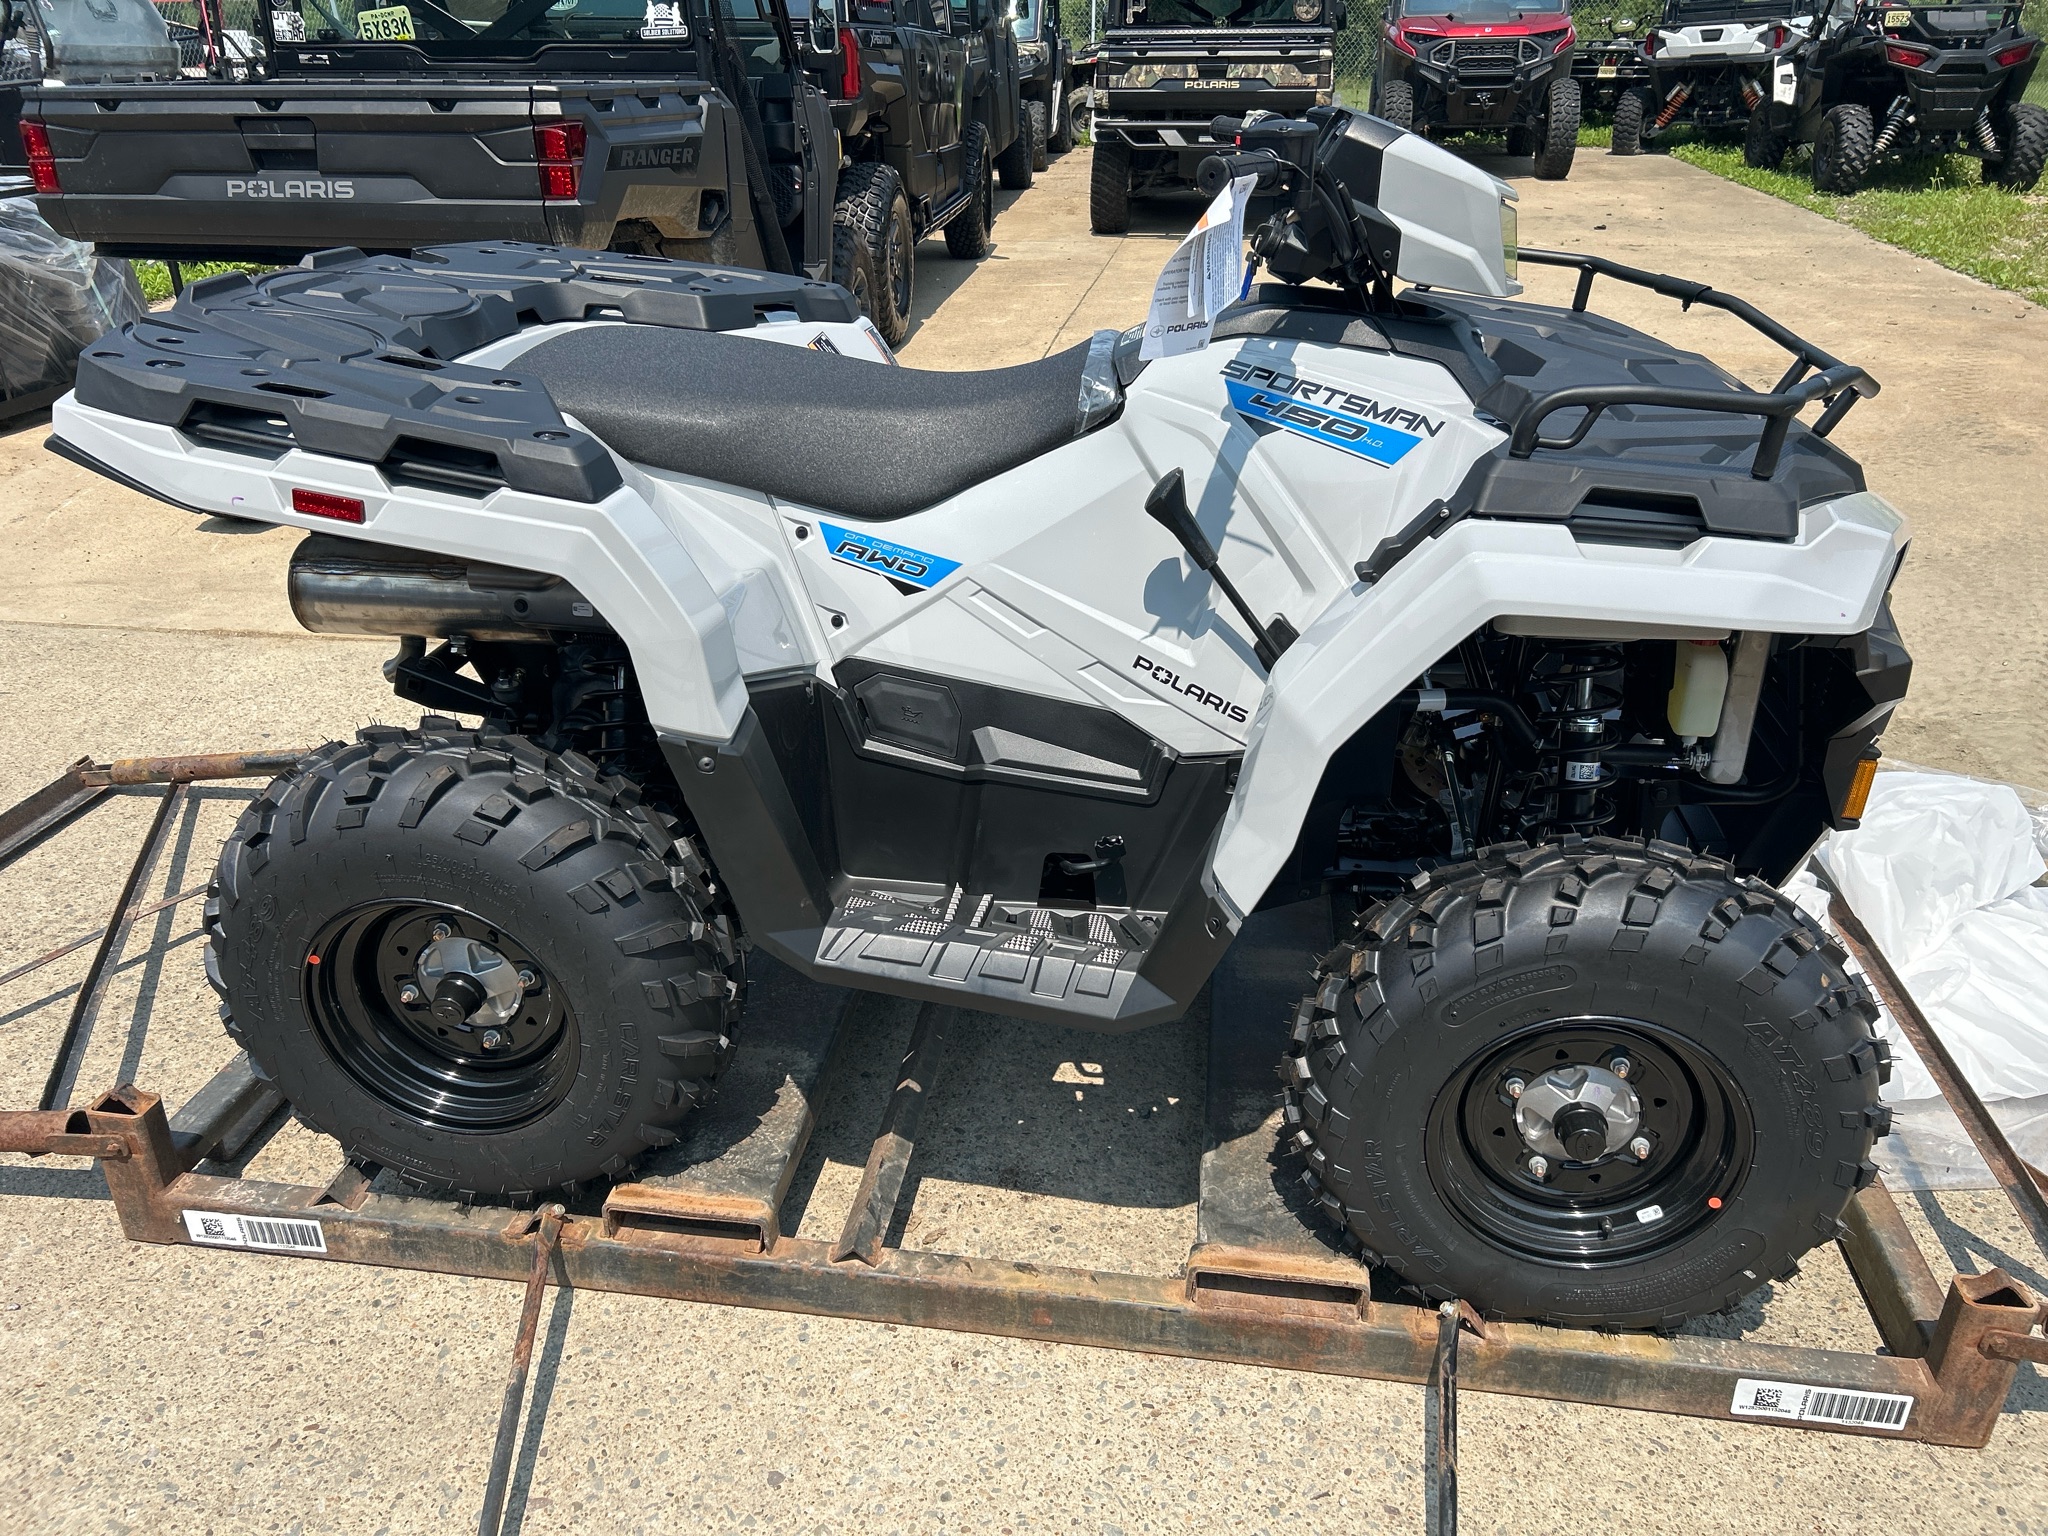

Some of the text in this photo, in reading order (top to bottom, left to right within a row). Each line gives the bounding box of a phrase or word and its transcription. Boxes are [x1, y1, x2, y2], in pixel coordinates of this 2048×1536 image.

[362, 16, 411, 40] 5X83K
[661, 28, 685, 36] SOLUTIONS
[1184, 81, 1240, 89] POLARIS
[620, 147, 695, 167] RANGER
[227, 180, 355, 199] POLARIS
[1166, 320, 1208, 334] POLARIS
[1218, 359, 1446, 438] SPORTSMAN
[1249, 393, 1384, 448] 450 H.O.
[835, 540, 928, 578] AWD
[844, 532, 934, 565] ON DEMAND
[1132, 654, 1249, 723] POLARIS
[1481, 985, 1535, 1007] TUBELESS
[585, 1022, 639, 1149] CARLSTAR
[1743, 1021, 1825, 1159] AT489
[1364, 1139, 1448, 1273] CARLSTAR
[1797, 1388, 1812, 1421] POLARIS
